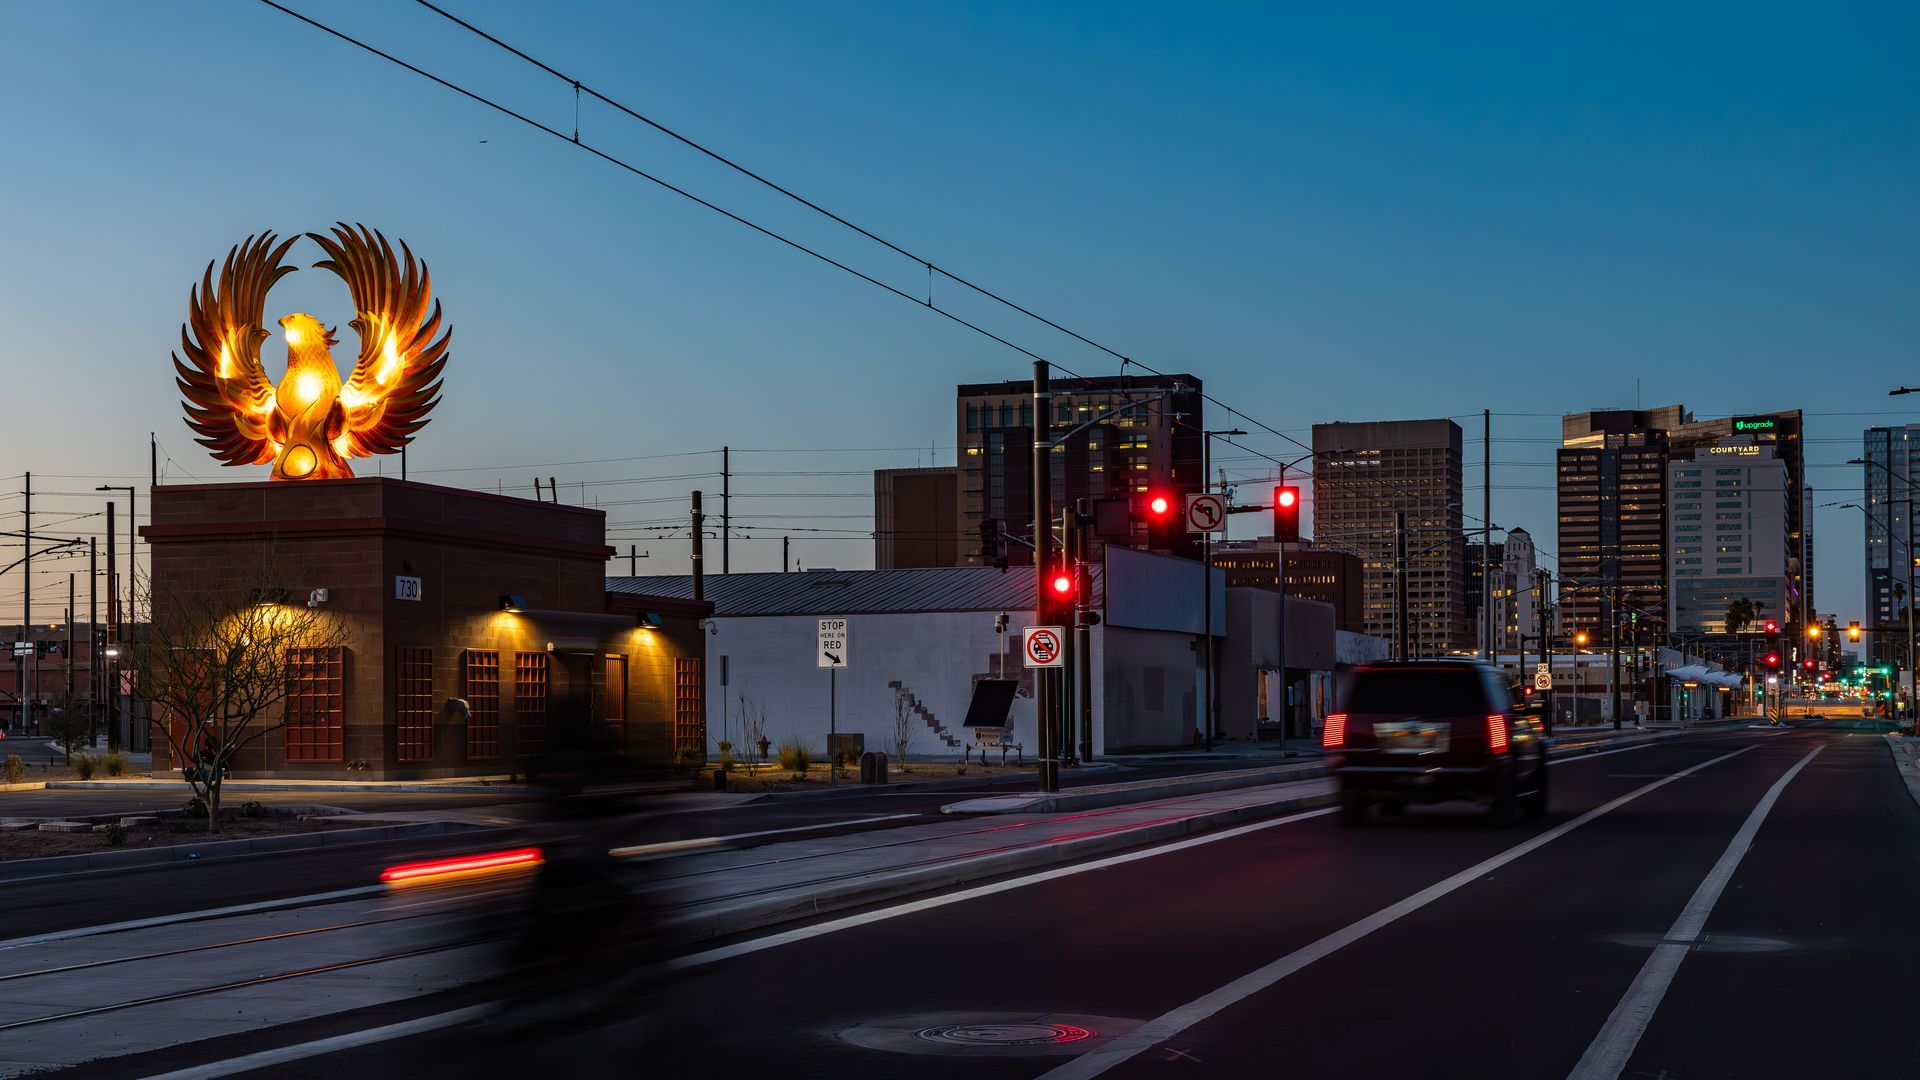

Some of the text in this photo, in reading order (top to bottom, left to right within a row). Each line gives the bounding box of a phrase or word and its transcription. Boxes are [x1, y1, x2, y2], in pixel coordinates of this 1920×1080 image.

[1744, 420, 1774, 430] upgrade
[1710, 445, 1760, 454] COURTYARD
[400, 579, 418, 598] 730
[821, 621, 845, 630] STOP
[823, 640, 842, 650] RED
